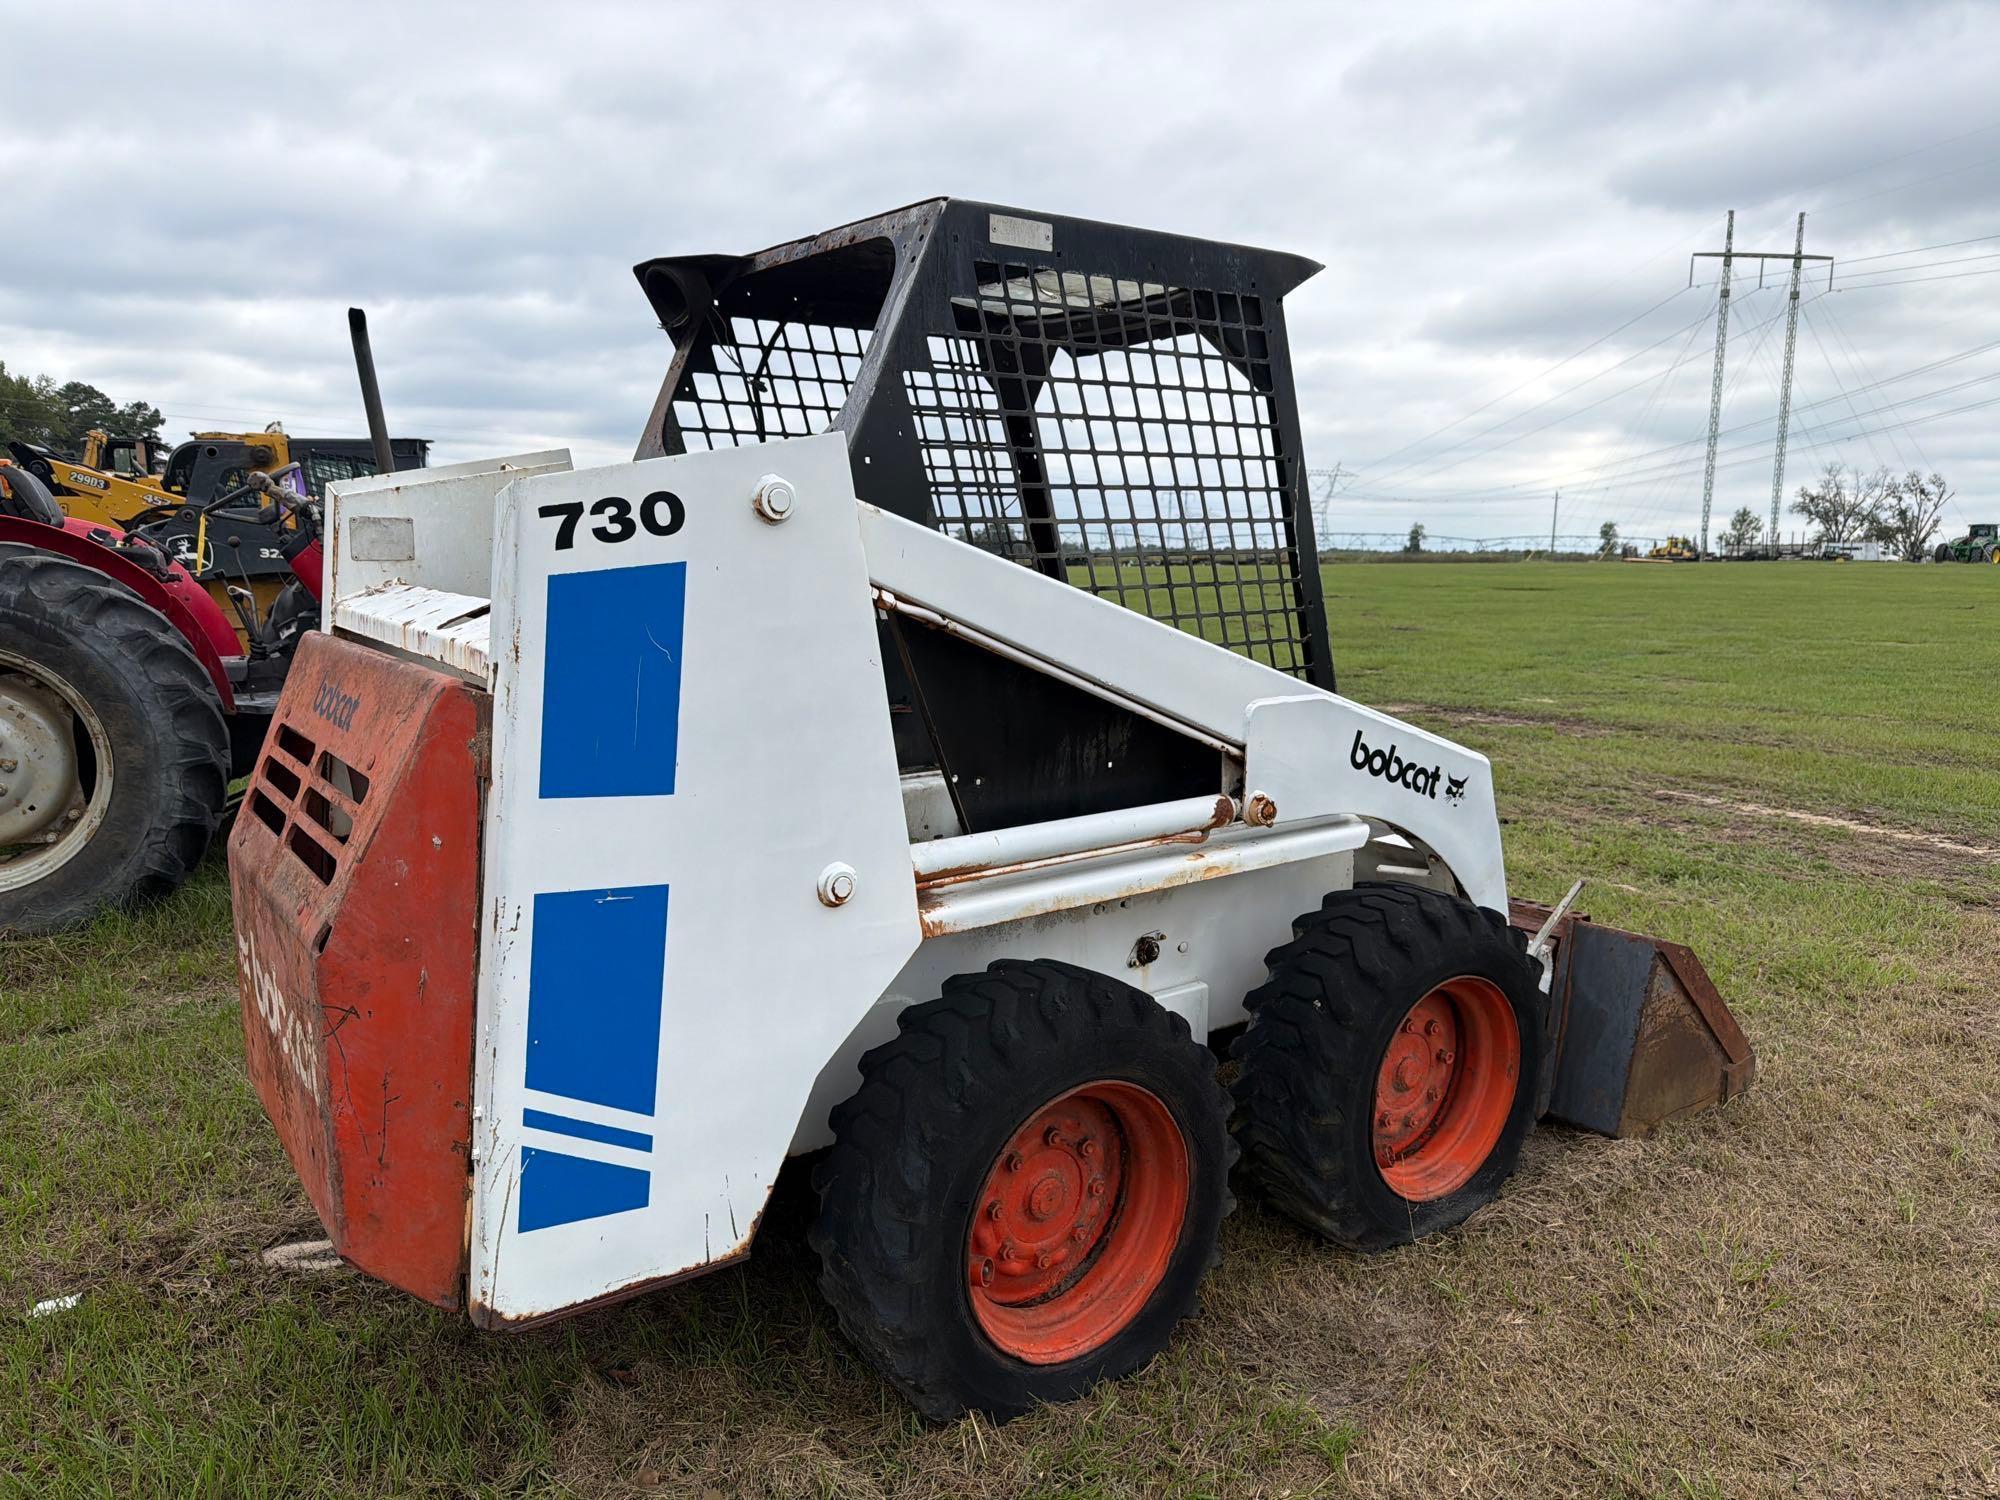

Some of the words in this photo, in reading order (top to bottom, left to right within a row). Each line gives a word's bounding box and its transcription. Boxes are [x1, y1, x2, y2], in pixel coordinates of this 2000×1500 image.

[70, 471, 105, 489] 299D3
[538, 491, 686, 551] 730
[259, 548, 285, 560] 32
[313, 670, 362, 732] bobcat
[1350, 729, 1441, 799] bobcat
